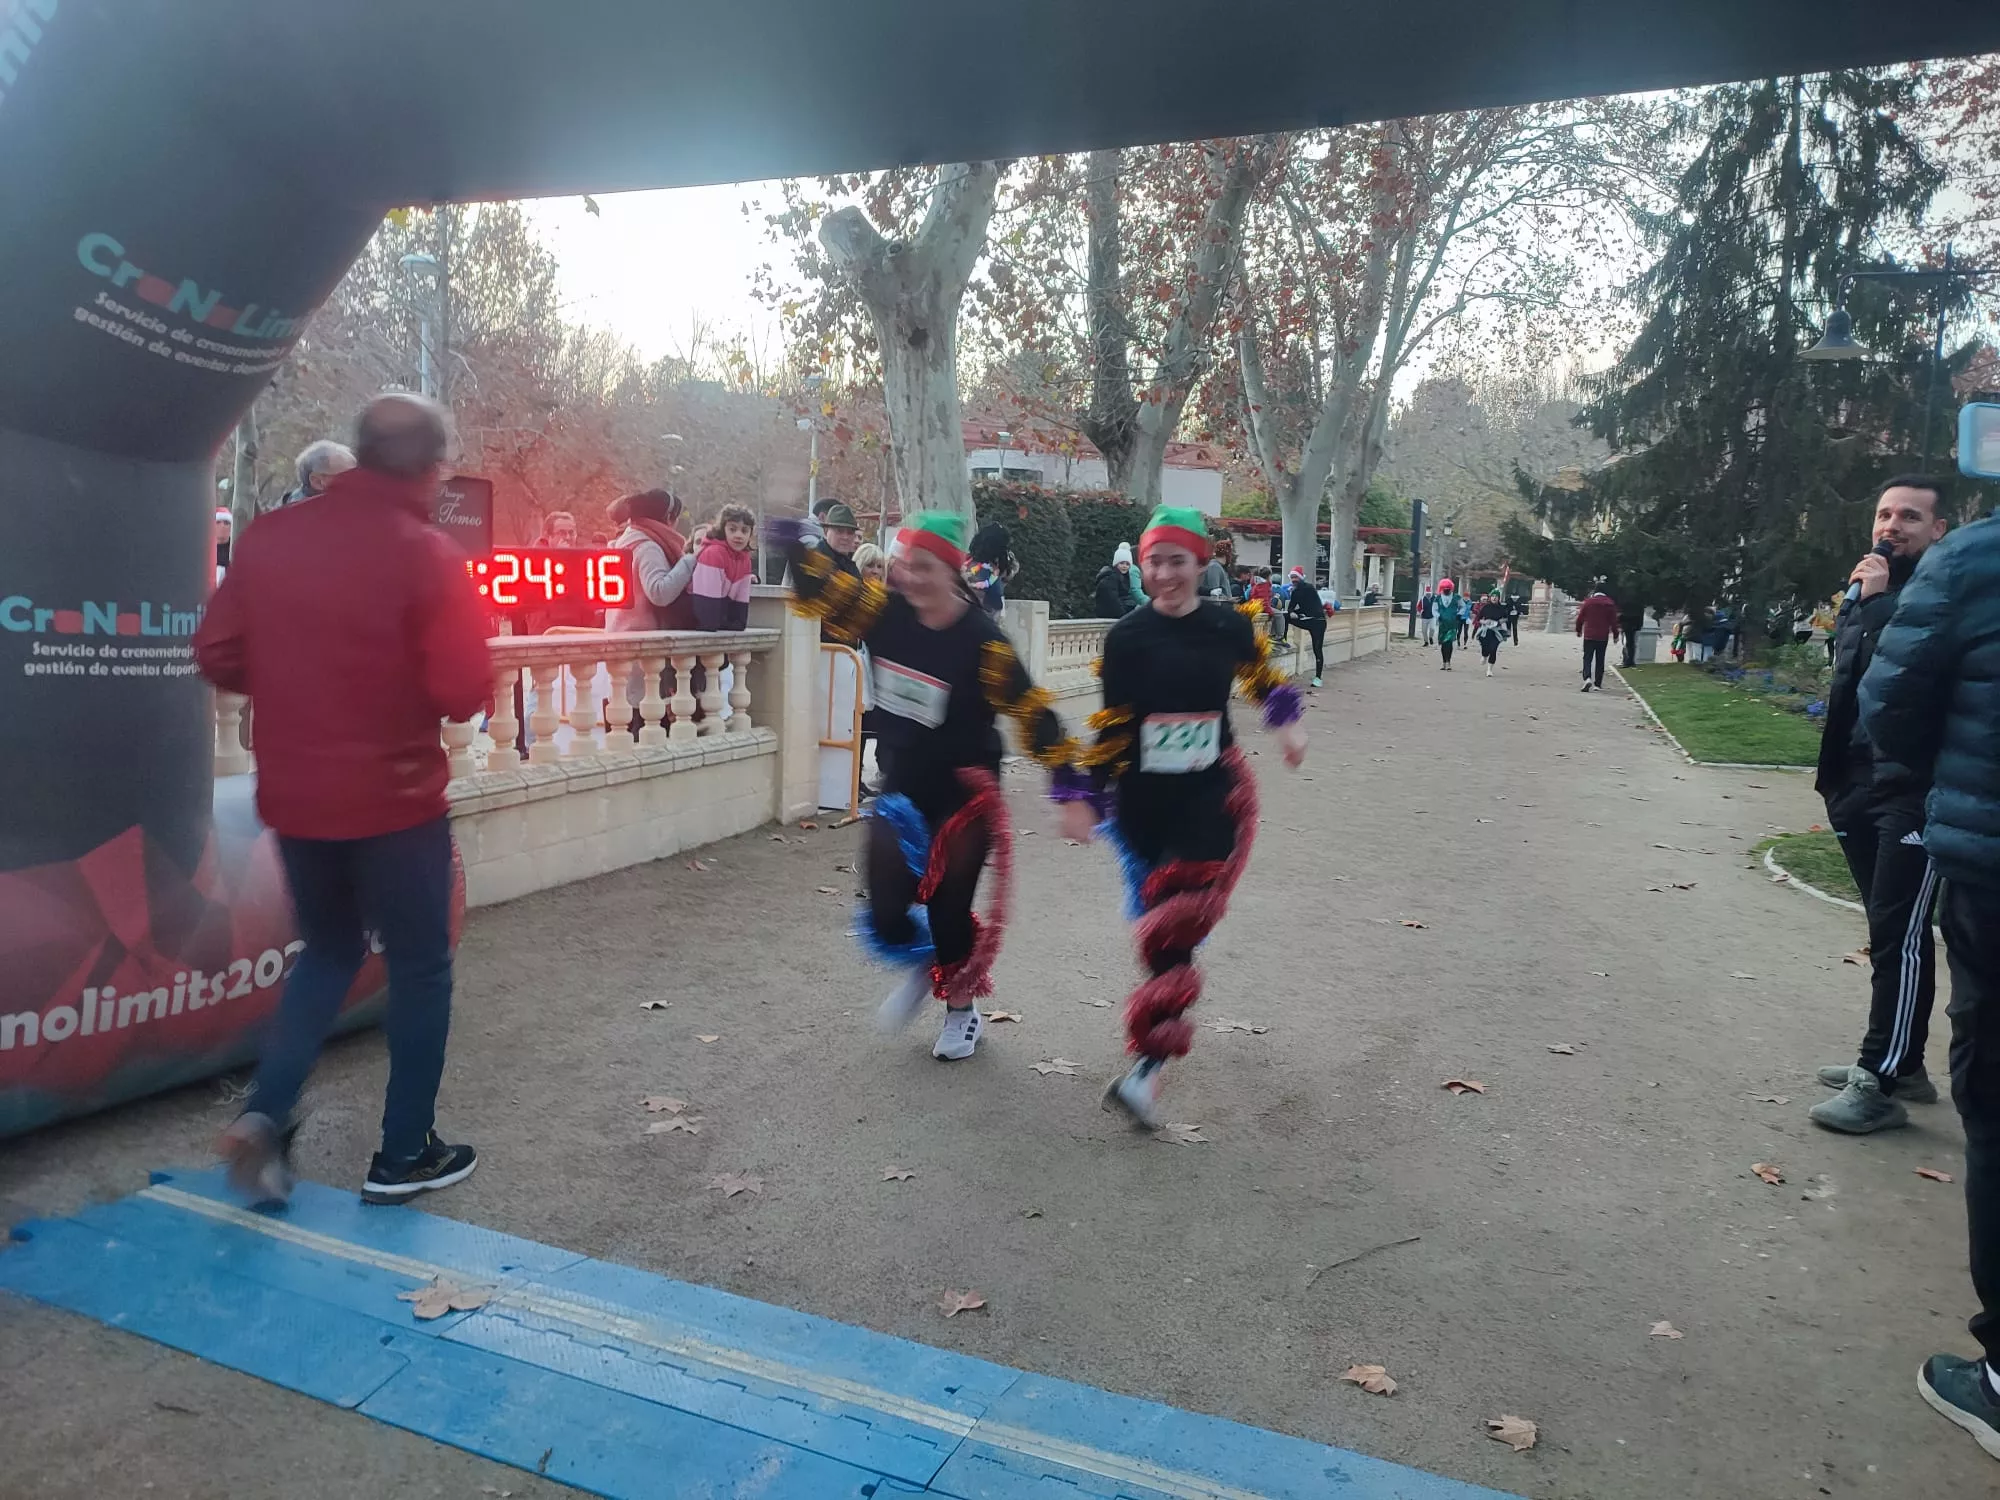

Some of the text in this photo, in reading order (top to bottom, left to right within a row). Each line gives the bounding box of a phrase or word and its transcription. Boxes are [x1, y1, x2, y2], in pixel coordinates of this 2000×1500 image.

[73, 306, 145, 347] gestión
[148, 340, 173, 358] de
[95, 291, 168, 334] Servicio
[170, 327, 194, 344] de
[32, 641, 95, 658] Servicio
[99, 643, 118, 658] de
[24, 661, 85, 677] gestión
[89, 662, 109, 677] de
[112, 663, 160, 677] eventos
